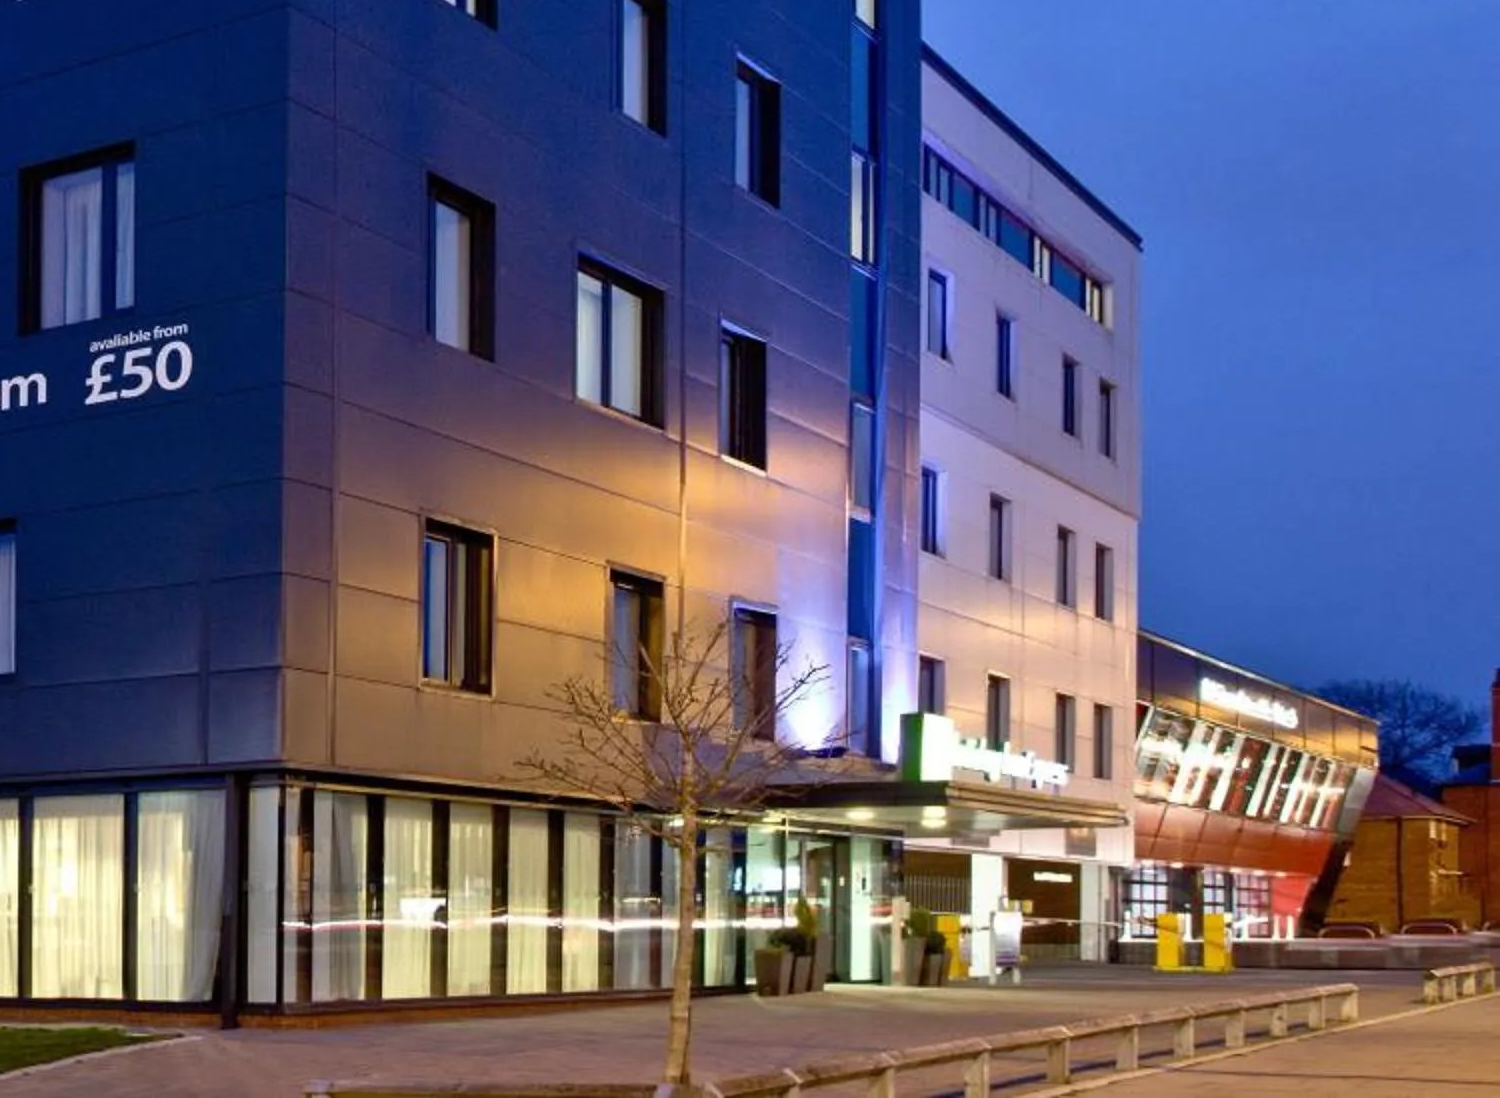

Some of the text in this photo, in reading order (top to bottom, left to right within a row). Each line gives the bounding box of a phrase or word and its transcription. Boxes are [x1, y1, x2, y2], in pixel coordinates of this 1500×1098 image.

[89, 323, 189, 352] available from
[84, 341, 193, 405] £50
